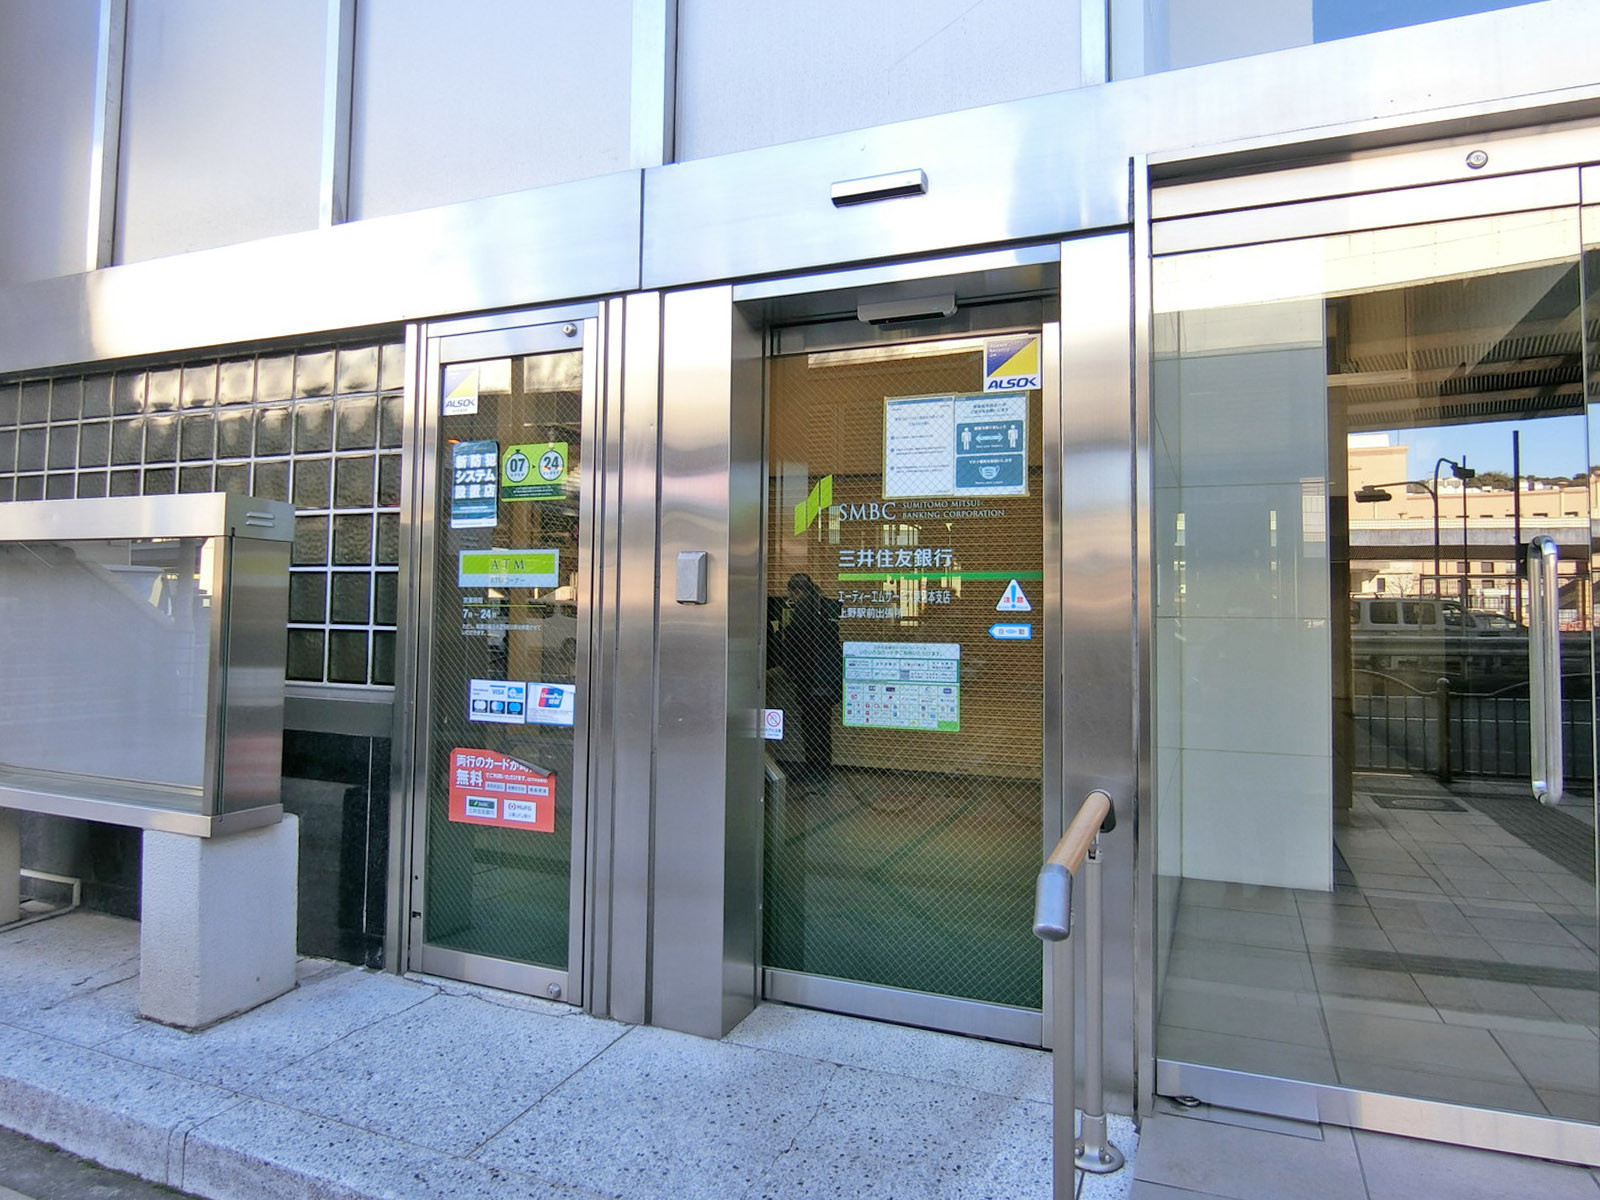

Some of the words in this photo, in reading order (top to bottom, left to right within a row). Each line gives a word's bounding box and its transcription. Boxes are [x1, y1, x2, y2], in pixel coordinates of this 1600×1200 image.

[987, 377, 1037, 390] ALSOK
[445, 398, 475, 408] ALSOK
[509, 458, 526, 473] 07
[543, 456, 560, 471] 24
[455, 468, 496, 484] システム
[838, 502, 897, 521] SMBC
[902, 500, 949, 509] SUMITOMO
[902, 511, 941, 519] BANKING
[943, 509, 1005, 518] CORPORATION
[490, 558, 525, 570] ATM
[838, 548, 953, 568] 三井住友銀行
[455, 768, 483, 787] 無料
